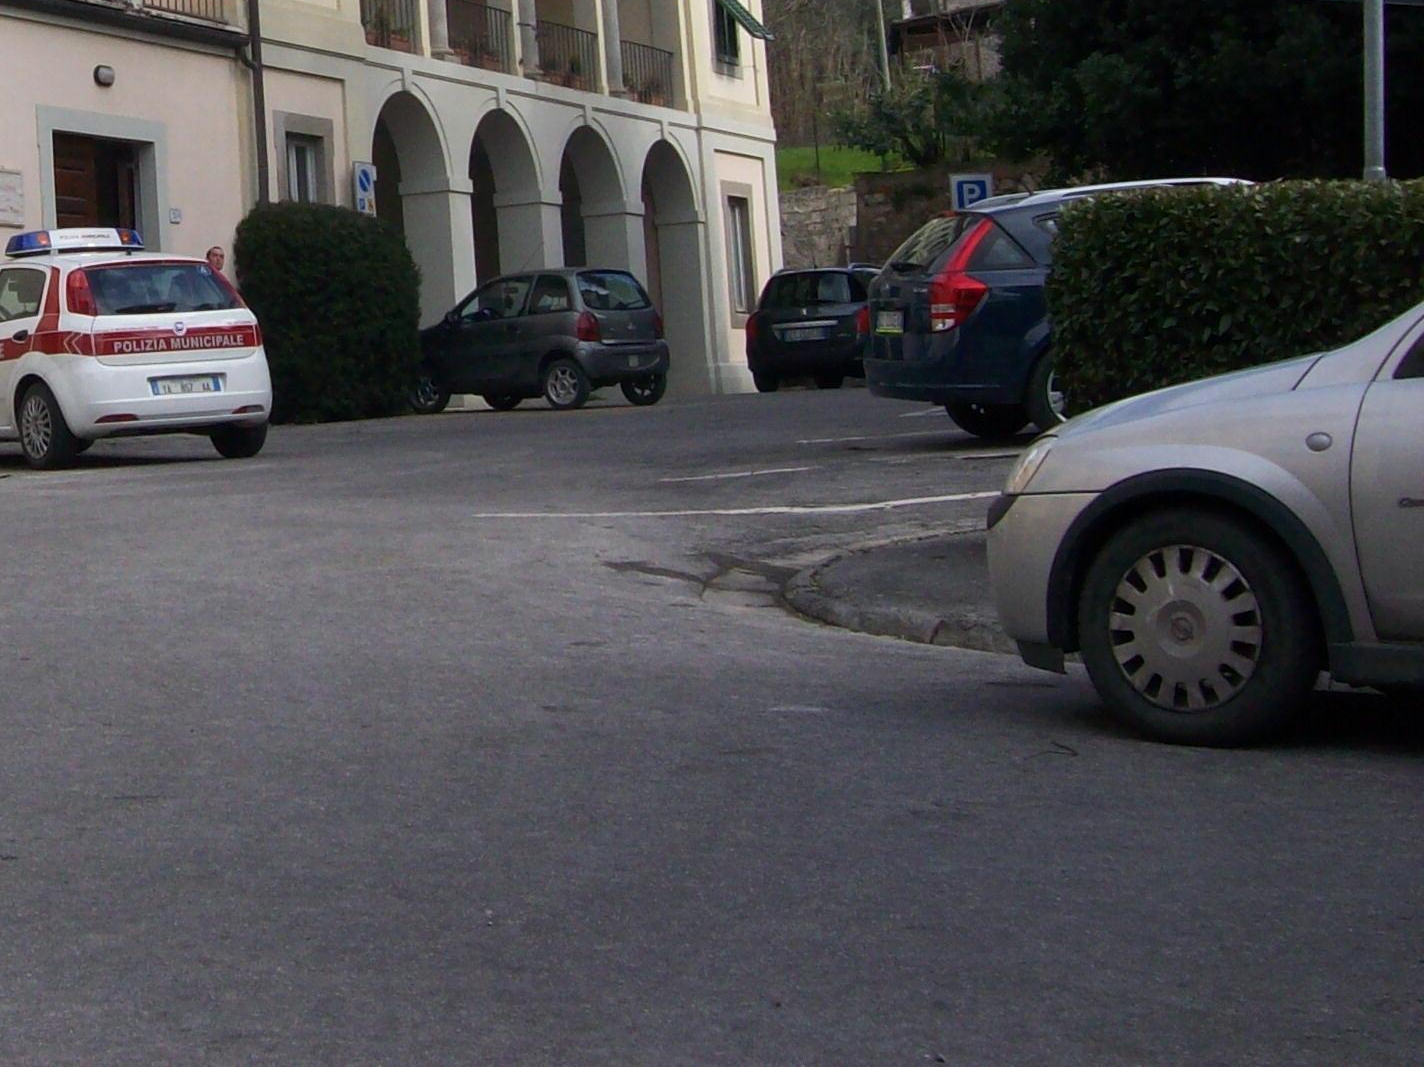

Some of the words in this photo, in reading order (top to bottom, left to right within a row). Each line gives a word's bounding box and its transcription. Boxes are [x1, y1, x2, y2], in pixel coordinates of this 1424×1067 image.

[962, 182, 981, 209] P
[114, 340, 168, 353] POLIZIA
[171, 335, 244, 350] MUNICIPALE
